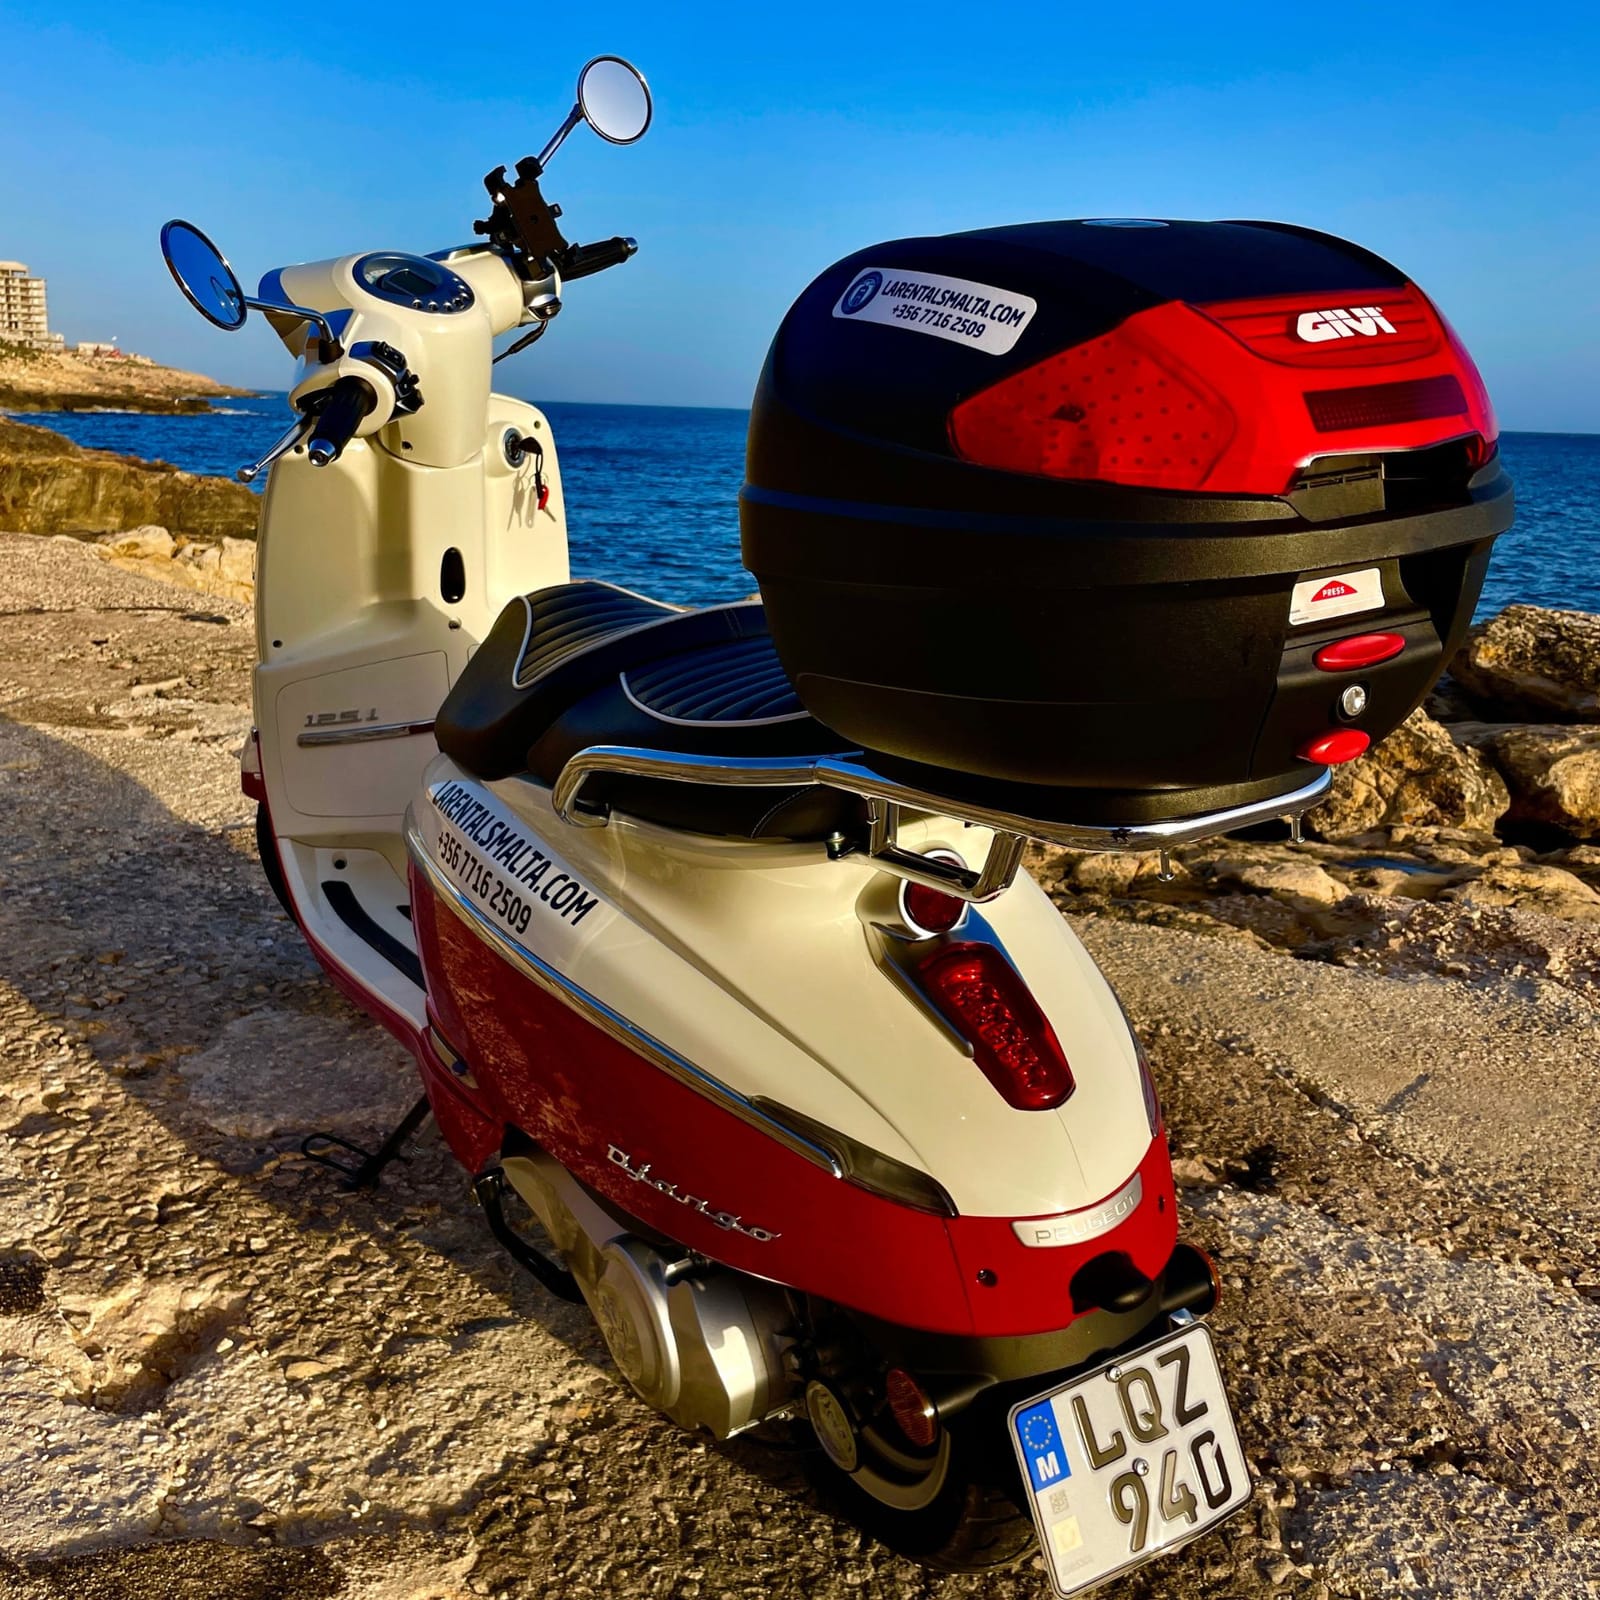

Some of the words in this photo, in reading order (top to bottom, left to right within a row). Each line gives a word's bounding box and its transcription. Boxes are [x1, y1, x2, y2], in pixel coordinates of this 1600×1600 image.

[881, 280, 1026, 328] LARENTALSMALTA.COM
[892, 304, 919, 321] +356
[918, 308, 951, 329] 7716
[949, 317, 987, 339] 2509
[1322, 586, 1345, 598] PRESS
[432, 780, 599, 926] LARENTALSMALTA.COM
[438, 831, 462, 871] +356
[459, 850, 493, 899] 7716
[489, 880, 532, 935] 2509
[606, 1143, 782, 1242] Django
[1035, 1191, 1136, 1244] PEUGEOT
[1071, 1345, 1209, 1471] LQZ
[1035, 1451, 1061, 1482] M
[1110, 1429, 1233, 1553] 940
